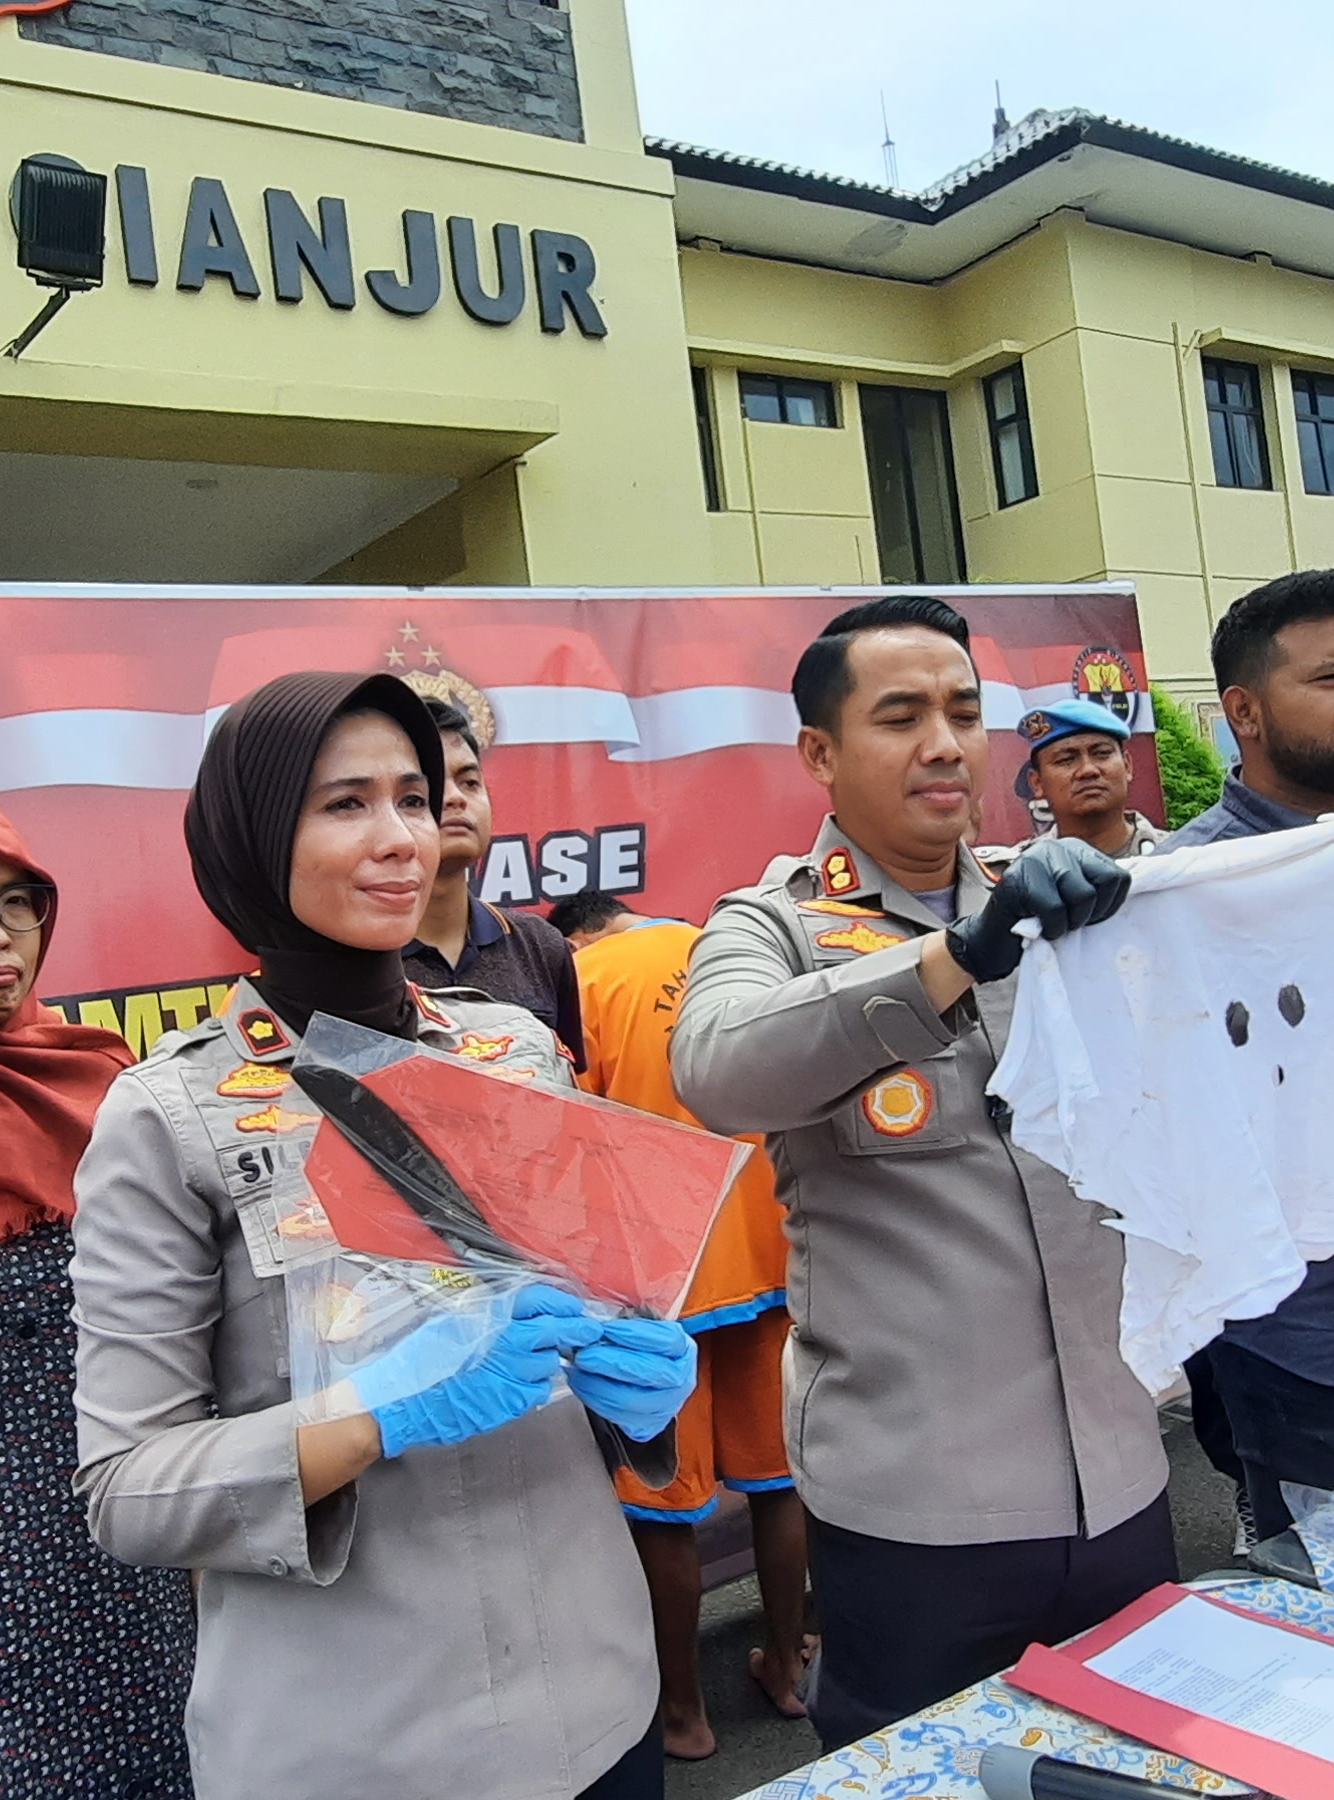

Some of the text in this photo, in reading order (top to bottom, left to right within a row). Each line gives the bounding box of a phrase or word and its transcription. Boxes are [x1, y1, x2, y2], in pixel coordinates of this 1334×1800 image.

[9, 153, 607, 339] IANJUR
[475, 828, 643, 902] ASE
[653, 969, 687, 1014] TAH
